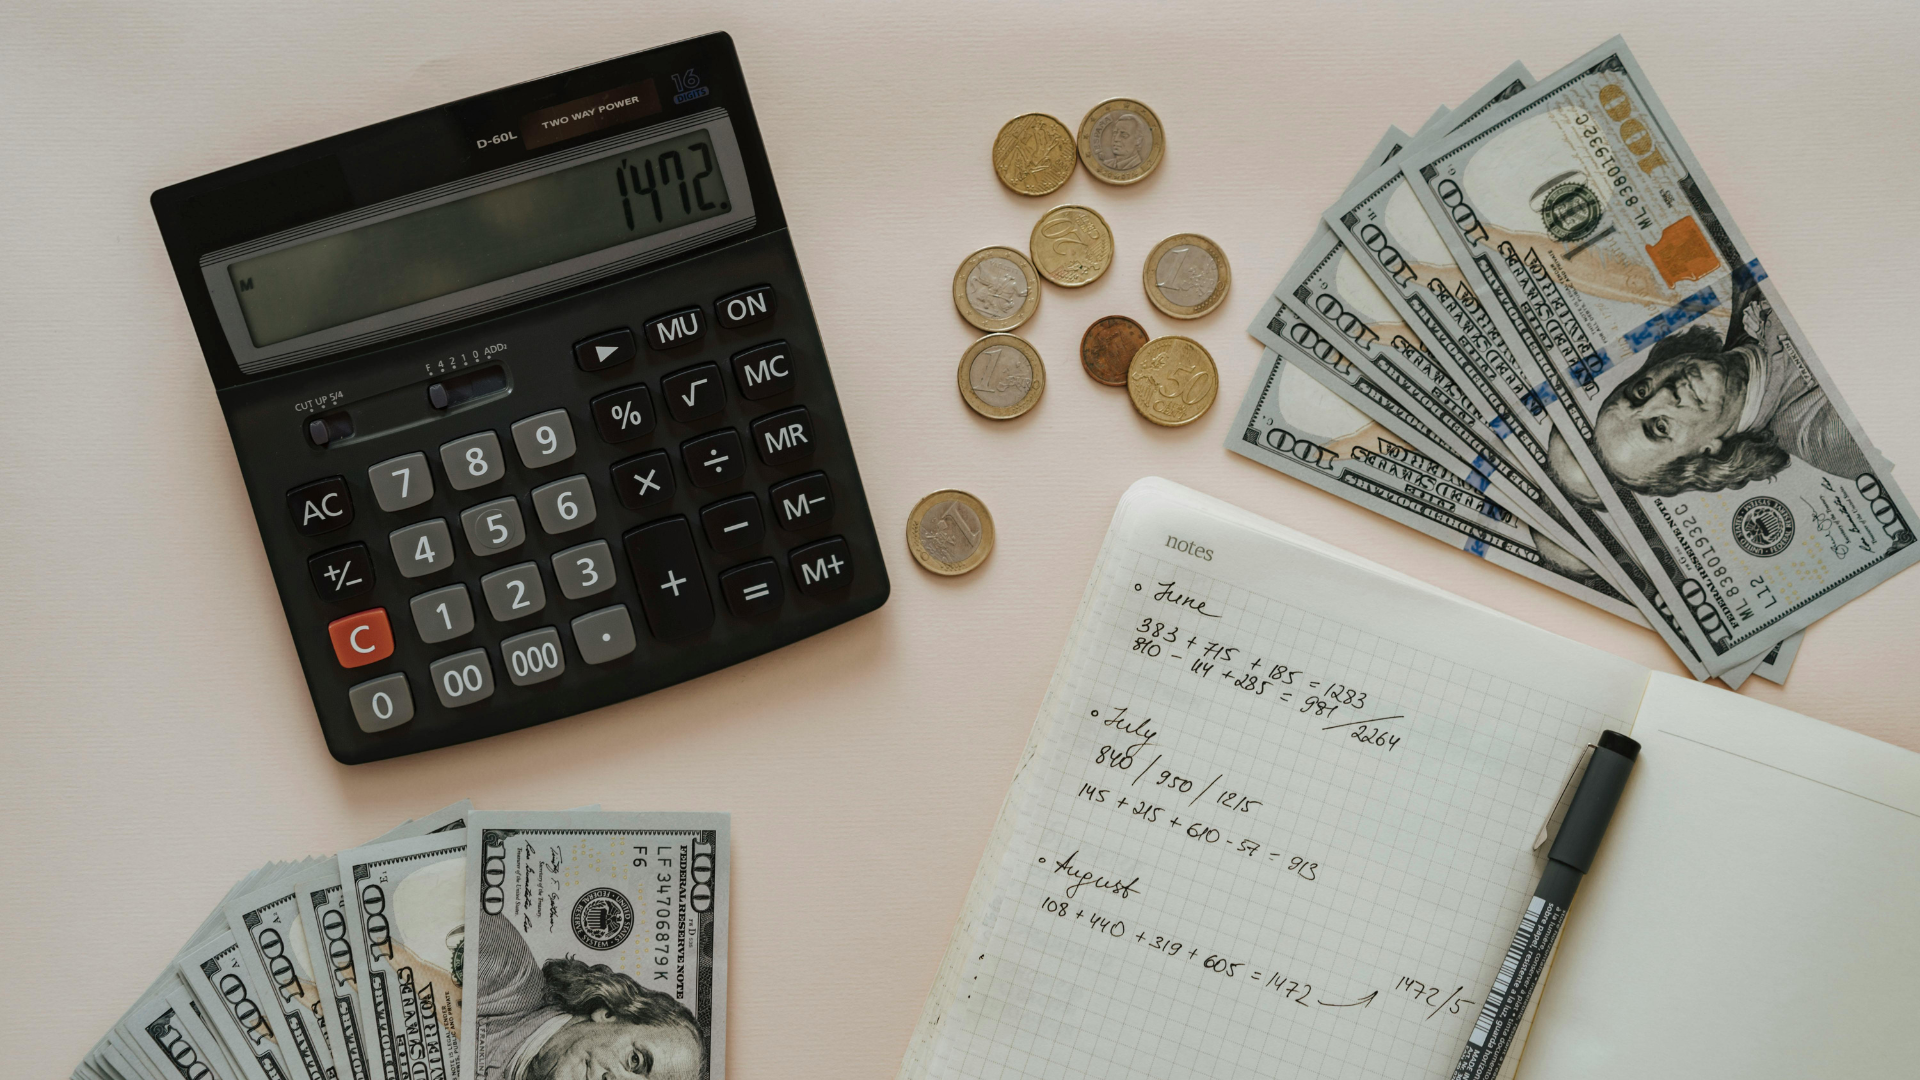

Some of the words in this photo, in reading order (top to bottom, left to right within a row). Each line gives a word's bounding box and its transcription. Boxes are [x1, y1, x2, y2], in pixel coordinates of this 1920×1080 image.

[671, 69, 700, 92] 16
[676, 86, 707, 103] DIGITS
[541, 116, 569, 130] TWO
[571, 108, 596, 121] WAY
[598, 95, 640, 113] POWER
[1599, 83, 1667, 172] 100
[476, 131, 517, 149] D-60L
[1580, 123, 1640, 209] 83801932
[1438, 178, 1490, 246] 100
[1631, 205, 1654, 231] ML
[1041, 209, 1088, 255] 20
[1359, 223, 1419, 287] 100
[240, 278, 253, 292] M
[727, 292, 767, 321] ON
[1315, 293, 1381, 349] 100
[656, 313, 699, 344] MU
[438, 360, 444, 368] 4
[449, 357, 456, 365] 2
[473, 350, 479, 359] 0
[1291, 322, 1356, 378] 100
[1783, 340, 1811, 380] FRANKLIN
[744, 355, 789, 386] MC
[972, 347, 1002, 393] 1
[1159, 361, 1213, 405] 50
[295, 400, 313, 412] CUT
[315, 396, 327, 406] UP
[329, 391, 343, 401] 5/4
[611, 401, 641, 430] %
[536, 426, 557, 454] 9
[765, 423, 808, 453] MR
[1267, 427, 1340, 470] 100
[465, 448, 488, 476] 8
[392, 468, 410, 498] 7
[303, 493, 343, 526] AC
[557, 491, 578, 520] 6
[1653, 496, 1677, 529] NOTE
[1856, 472, 1909, 541] 100
[486, 513, 508, 544] 5
[414, 536, 436, 563] 4
[1165, 535, 1214, 561] notes
[1671, 525, 1709, 580] RESERVE
[1680, 514, 1740, 599] 83801932
[576, 557, 599, 586] 3
[801, 554, 844, 585] M+
[506, 580, 530, 609] 2
[1154, 582, 1222, 617] June
[1703, 577, 1740, 630] FEDERAL
[1748, 573, 1778, 610] L12
[436, 603, 452, 629] 1
[1681, 577, 1734, 645] 100
[1731, 595, 1755, 622] ML
[349, 625, 375, 653] C
[511, 642, 558, 676] 000
[1137, 618, 1178, 642] 383
[1188, 637, 1196, 648] +
[1204, 642, 1240, 661] 715
[1251, 658, 1261, 670] +
[1269, 665, 1303, 684] 185
[1324, 683, 1366, 709] 1283
[443, 664, 483, 697] 00
[1133, 637, 1160, 657] 810
[1300, 696, 1338, 718] 981
[372, 692, 393, 719] 0
[1104, 707, 1157, 756] July
[1351, 725, 1400, 751] 2264
[1095, 746, 1133, 769] 840
[1156, 771, 1192, 792] 950
[1217, 791, 1263, 812] 1215
[1078, 783, 1110, 803] 145
[1118, 798, 1128, 808] +
[1133, 802, 1165, 822] 215
[1171, 817, 1182, 827] +
[1187, 823, 1220, 843] 610
[1237, 839, 1260, 856] 57
[1288, 857, 1318, 881] 913
[632, 845, 647, 868] F6
[656, 845, 671, 867] LF
[483, 840, 505, 915] 100
[677, 844, 687, 903] FEDERAL
[690, 838, 711, 913] 100
[1054, 850, 1141, 898] August
[361, 884, 394, 960] 100
[653, 872, 670, 966] 34706879
[1540, 902, 1555, 925] sobre
[1551, 912, 1559, 921] la
[321, 909, 359, 985] 100
[676, 903, 686, 964] RESERVE
[1528, 924, 1545, 950] papel,
[258, 928, 305, 1001] 100
[1042, 897, 1068, 917] 108
[1076, 910, 1084, 918] +
[1090, 913, 1125, 937] 440
[1149, 937, 1182, 955] 319
[1188, 949, 1198, 959] +
[1204, 955, 1245, 977] 605
[1266, 972, 1311, 1007] 1472
[675, 964, 684, 999] NOTE
[1512, 950, 1534, 988] resistente
[1522, 952, 1541, 988] conserver
[219, 973, 275, 1044] 100
[1499, 1003, 1511, 1019] luz,
[1505, 995, 1514, 1004] la
[1511, 994, 1524, 1011] plat
[1485, 1019, 1505, 1049] guarda
[1501, 1017, 1514, 1037] tinta
[477, 1027, 485, 1072] FRANKLIN
[1459, 1060, 1467, 1071] Nr.
[1464, 1046, 1474, 1060] Art.
[1466, 1048, 1480, 1072] MADE
[1472, 1048, 1492, 1080] horizon
